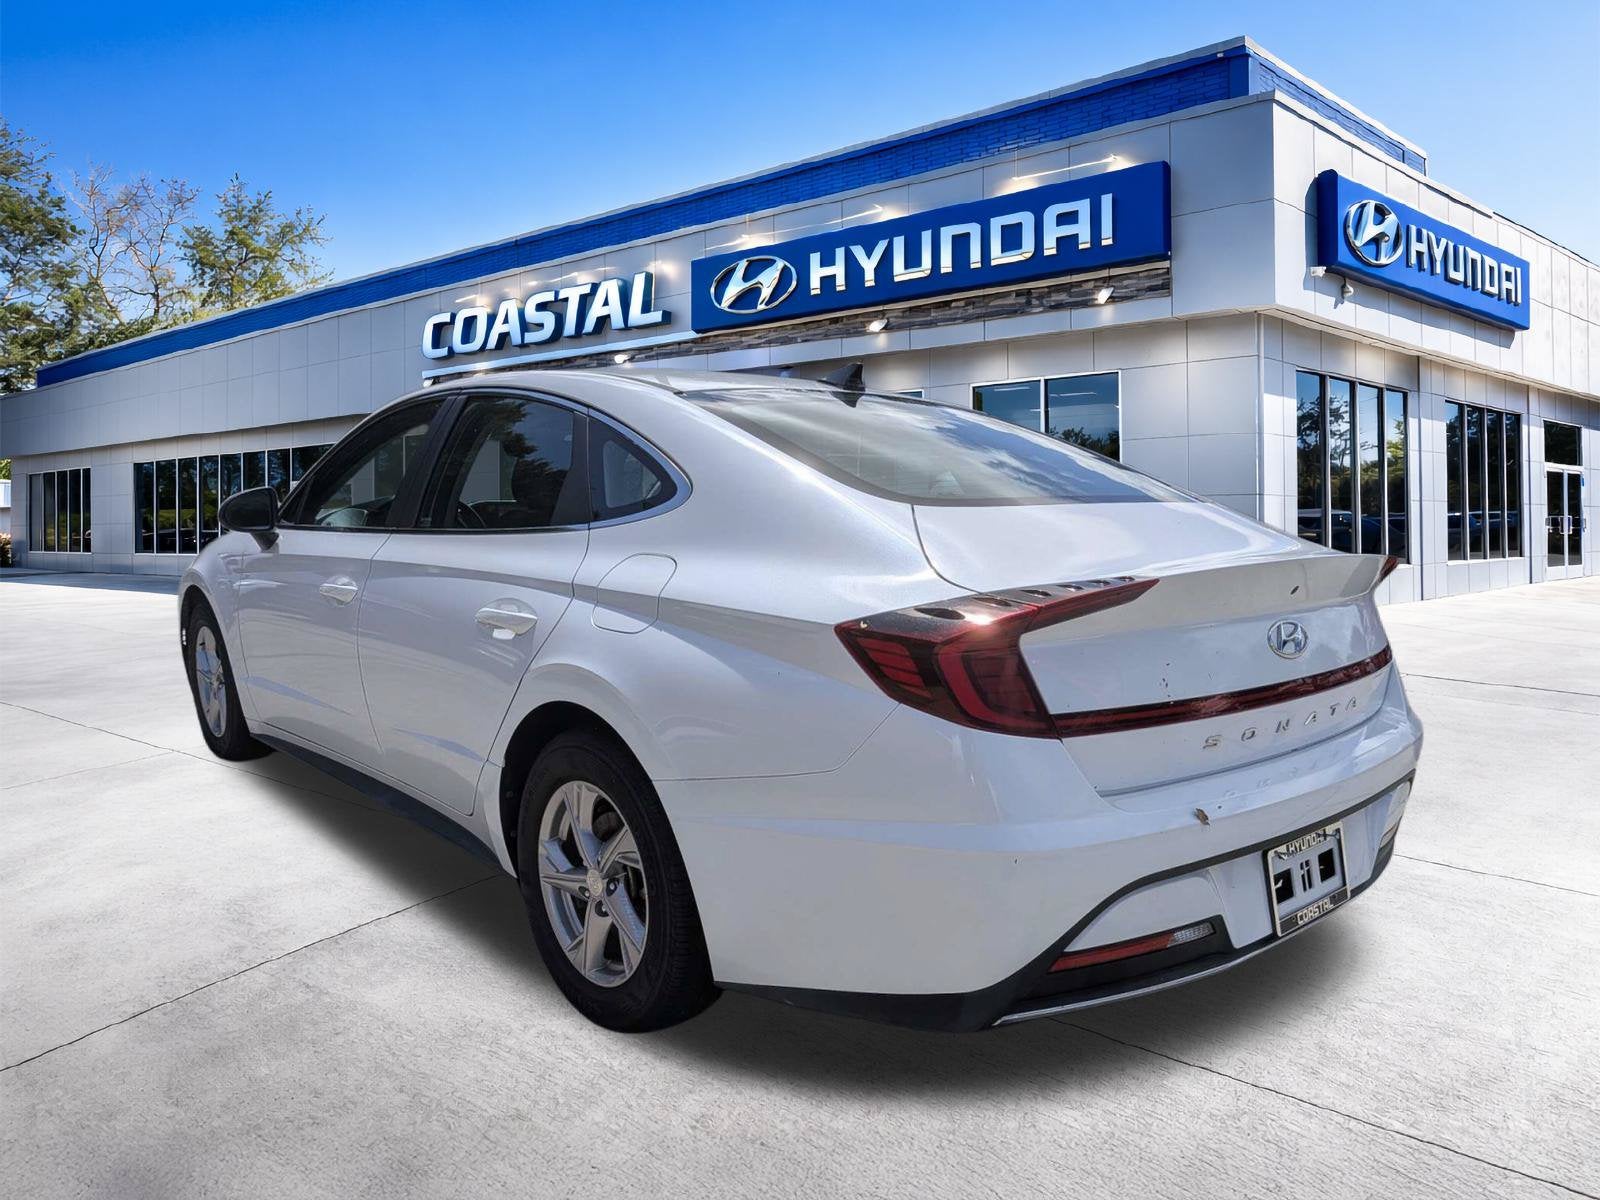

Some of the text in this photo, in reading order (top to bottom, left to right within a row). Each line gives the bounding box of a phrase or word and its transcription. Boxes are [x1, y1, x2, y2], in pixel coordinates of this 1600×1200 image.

[810, 193, 1113, 295] HYUNDAI
[1407, 225, 1520, 306] HYUNDAI
[422, 271, 669, 359] COASTAL
[1203, 697, 1359, 749] SONATA
[1297, 898, 1334, 924] COASTAL
